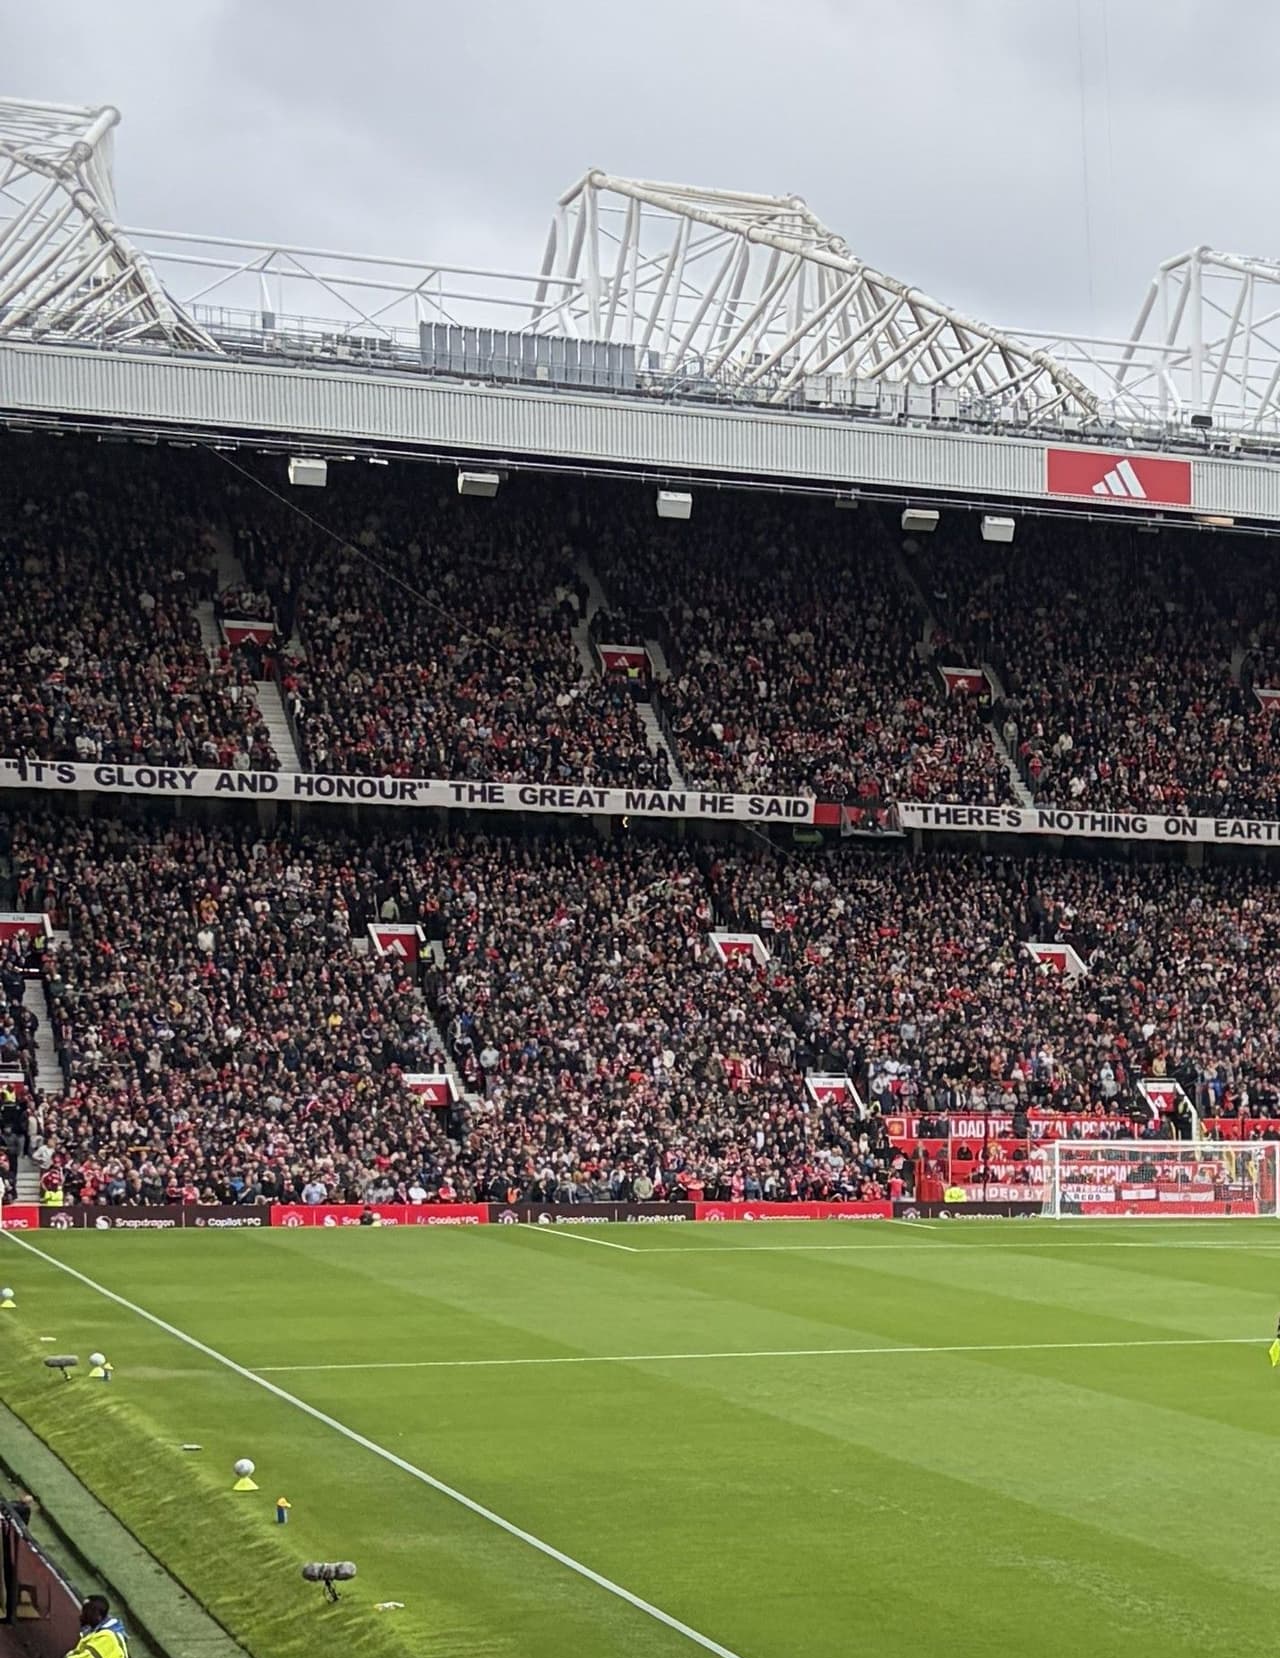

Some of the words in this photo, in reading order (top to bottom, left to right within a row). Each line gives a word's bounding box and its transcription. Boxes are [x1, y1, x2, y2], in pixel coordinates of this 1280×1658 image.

[94, 766, 199, 790] GLORY
[214, 772, 279, 794] AND
[293, 775, 430, 801] HONOUR"
[450, 783, 504, 805] THE
[519, 785, 610, 810] GREAT
[625, 791, 685, 813] MAN
[700, 794, 734, 815] HE
[748, 795, 809, 818] SAID
[904, 804, 1022, 828] "THERE'S
[1038, 810, 1148, 835] NOTHING
[1164, 817, 1198, 837] ON
[115, 1217, 176, 1228] Snapdragon
